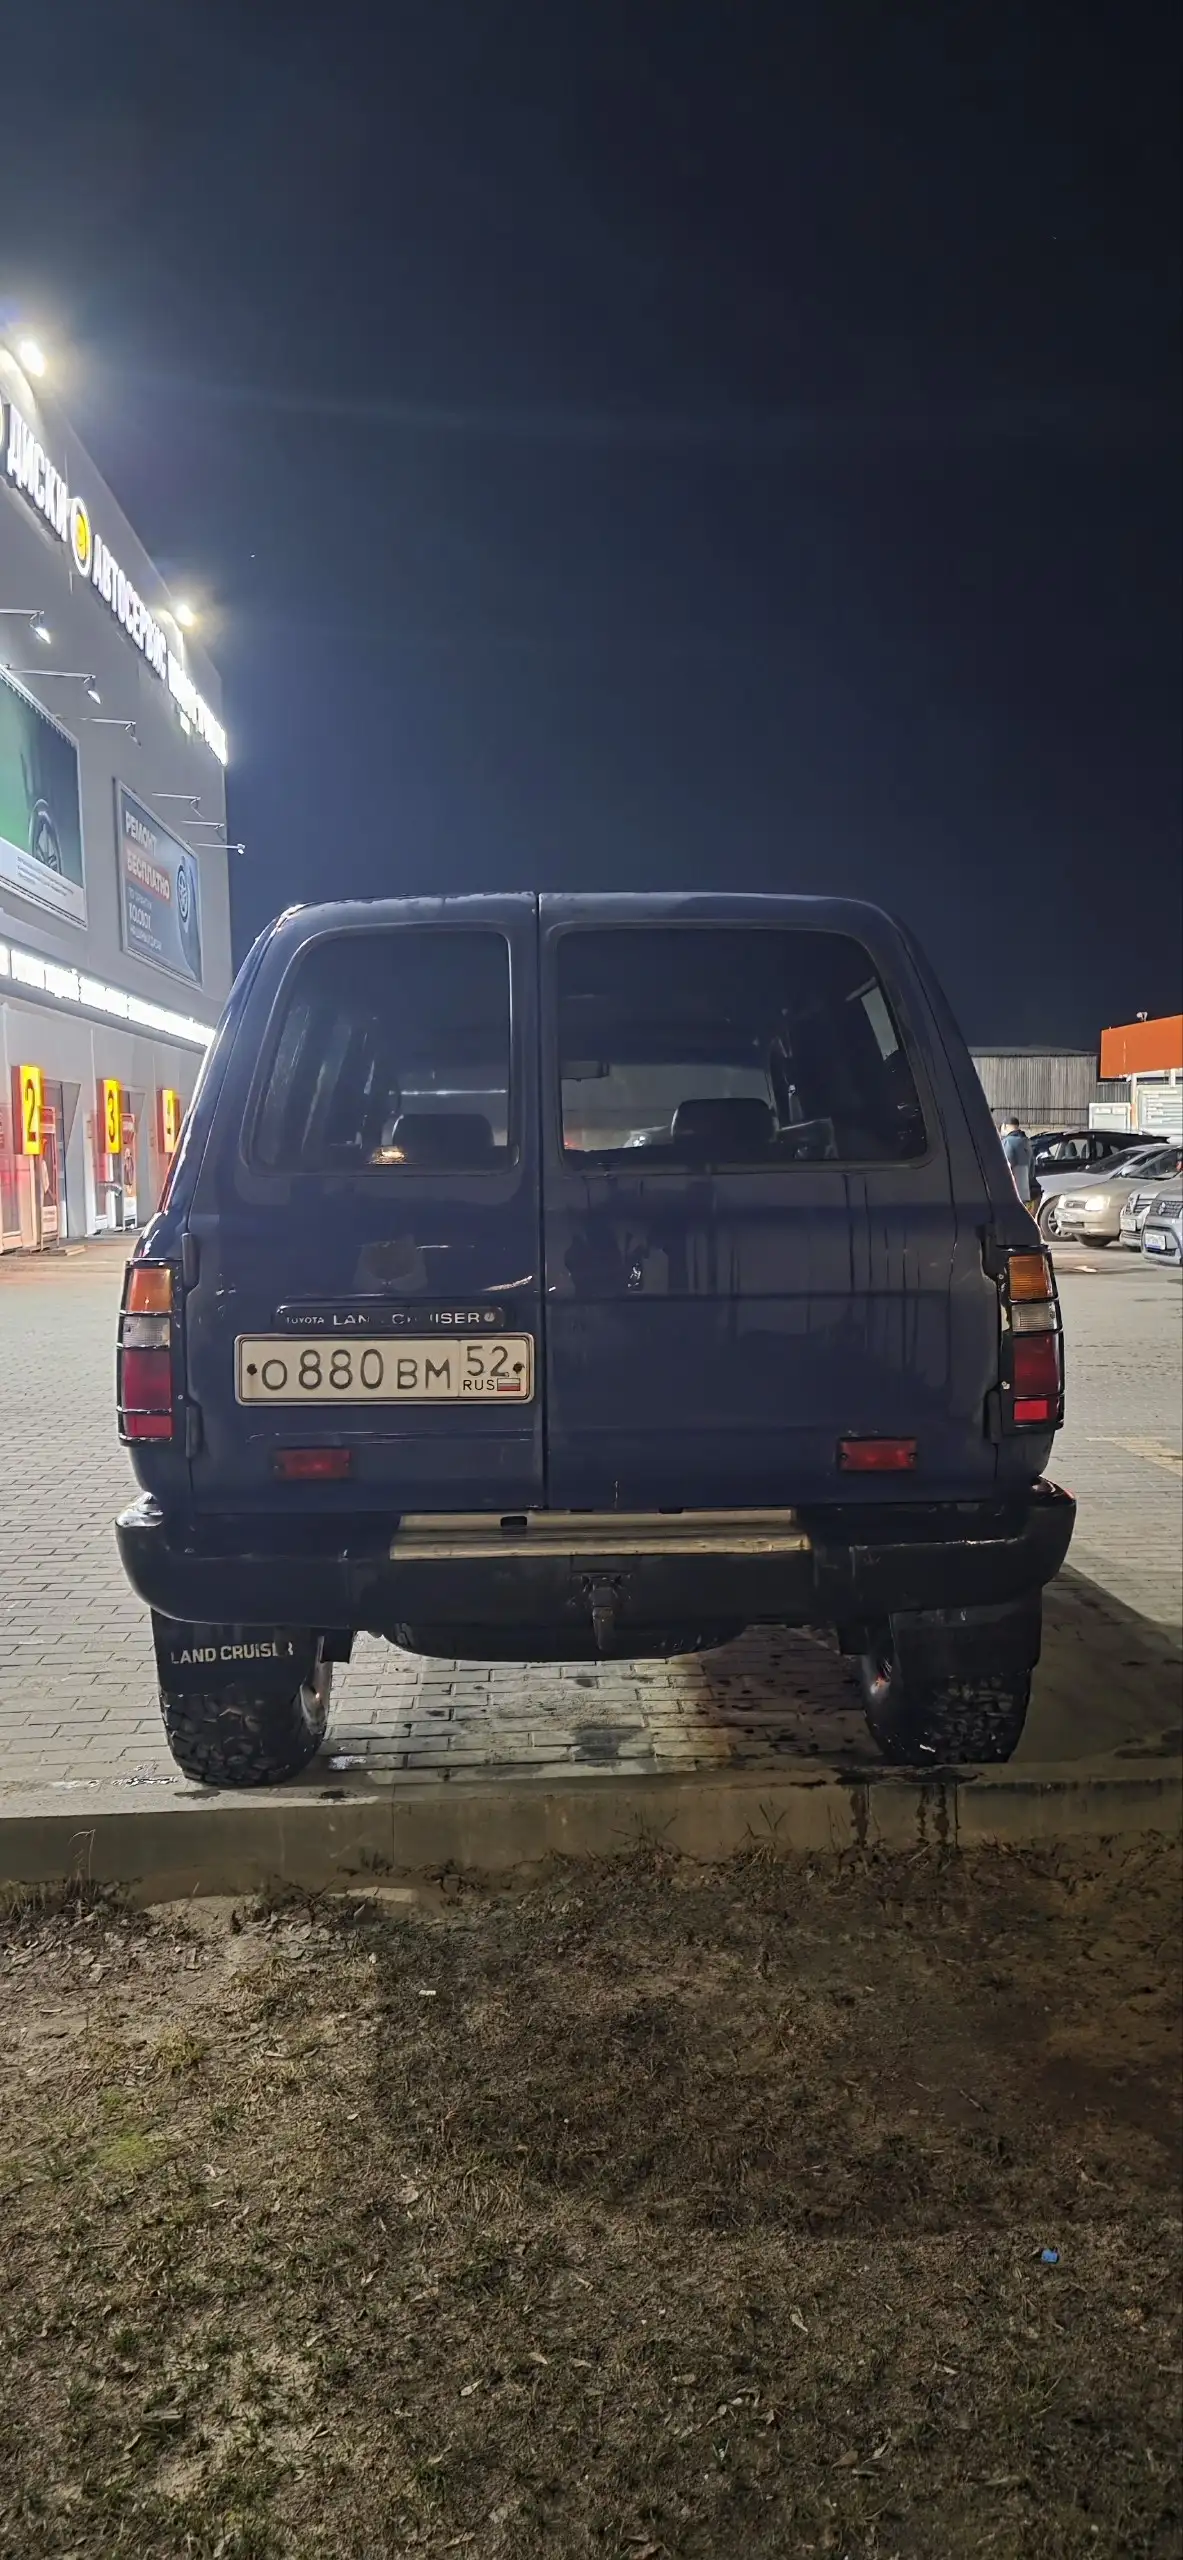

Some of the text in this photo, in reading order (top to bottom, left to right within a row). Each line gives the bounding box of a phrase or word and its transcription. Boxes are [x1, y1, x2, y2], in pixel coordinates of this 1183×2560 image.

[7, 403, 167, 680] ДИСКИ АВТОСЕРВИС
[24, 1078, 36, 1142] 2
[107, 1089, 116, 1143] 3
[286, 1312, 480, 1326] TOYOTA LAN CISER
[466, 1345, 509, 1377] 52
[463, 1379, 495, 1391] RUS
[170, 1647, 217, 1664] LAND
